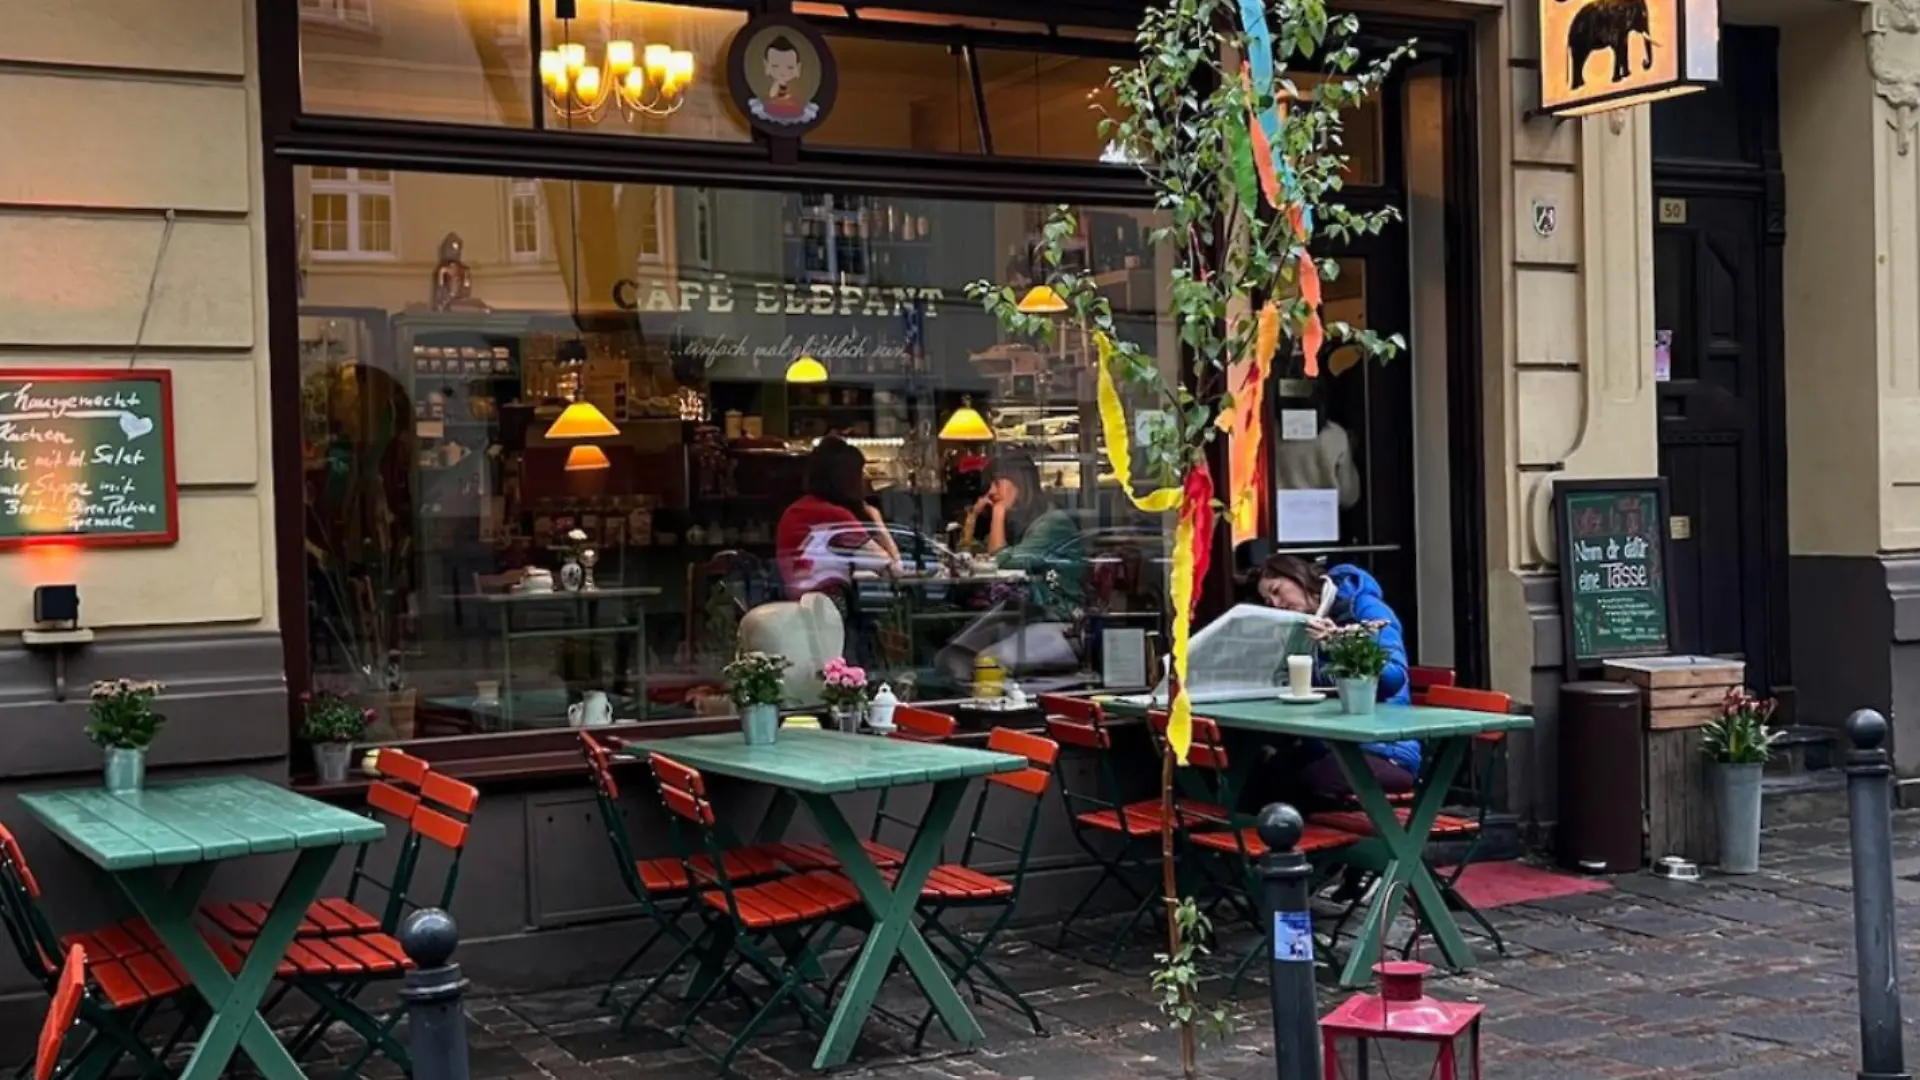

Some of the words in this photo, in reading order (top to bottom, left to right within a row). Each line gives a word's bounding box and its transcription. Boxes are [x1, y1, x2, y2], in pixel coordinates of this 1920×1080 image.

[1664, 203, 1682, 218] 50
[612, 273, 736, 313] CAFÉ
[755, 283, 944, 317] ELEFANT
[753, 335, 792, 360] mal
[91, 444, 146, 466] Salat
[99, 476, 136, 494] mit
[1599, 562, 1648, 589] Tasse
